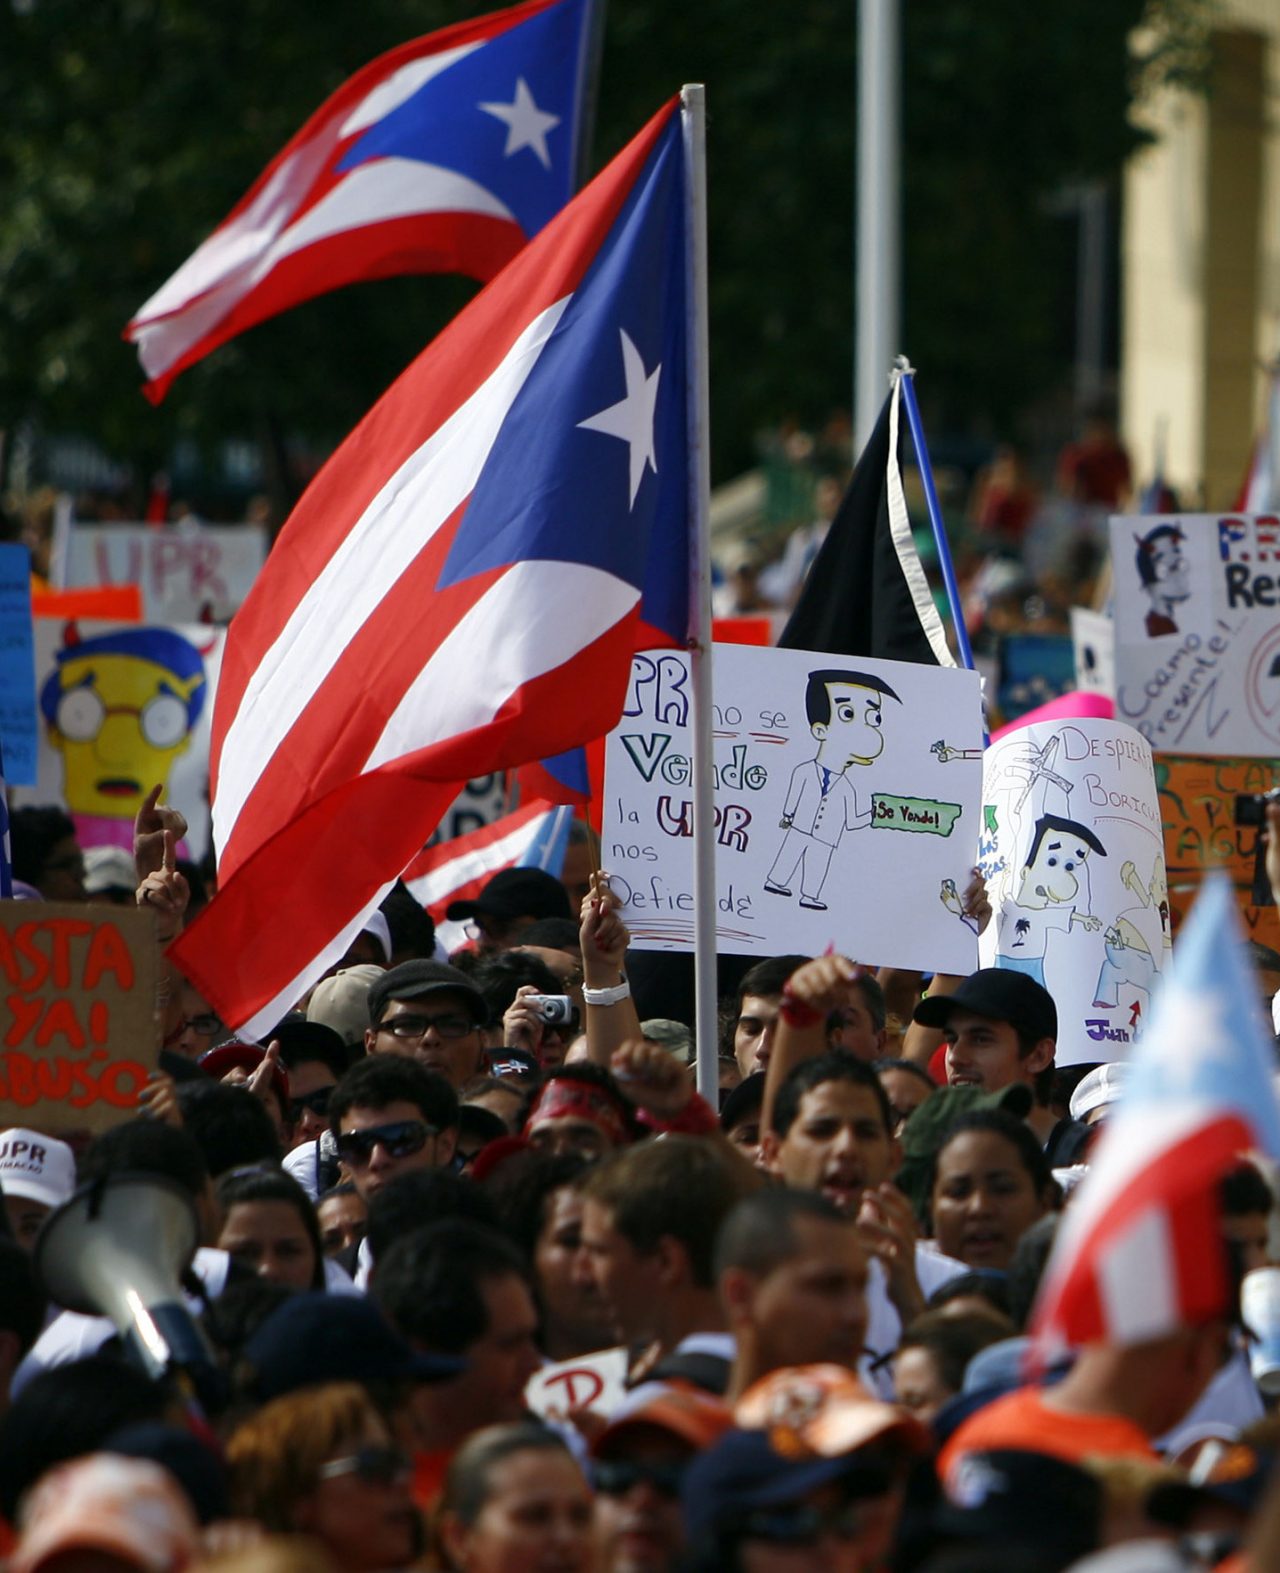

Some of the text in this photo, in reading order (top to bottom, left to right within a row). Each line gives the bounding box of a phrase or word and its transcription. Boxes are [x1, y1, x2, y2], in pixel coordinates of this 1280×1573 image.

[95, 537, 229, 601] UPR
[623, 654, 688, 727] PR
[759, 709, 789, 729] se
[618, 798, 640, 824] la
[613, 844, 659, 862] nos
[5, 996, 109, 1061] YA!
[0, 1051, 150, 1109] BUSO
